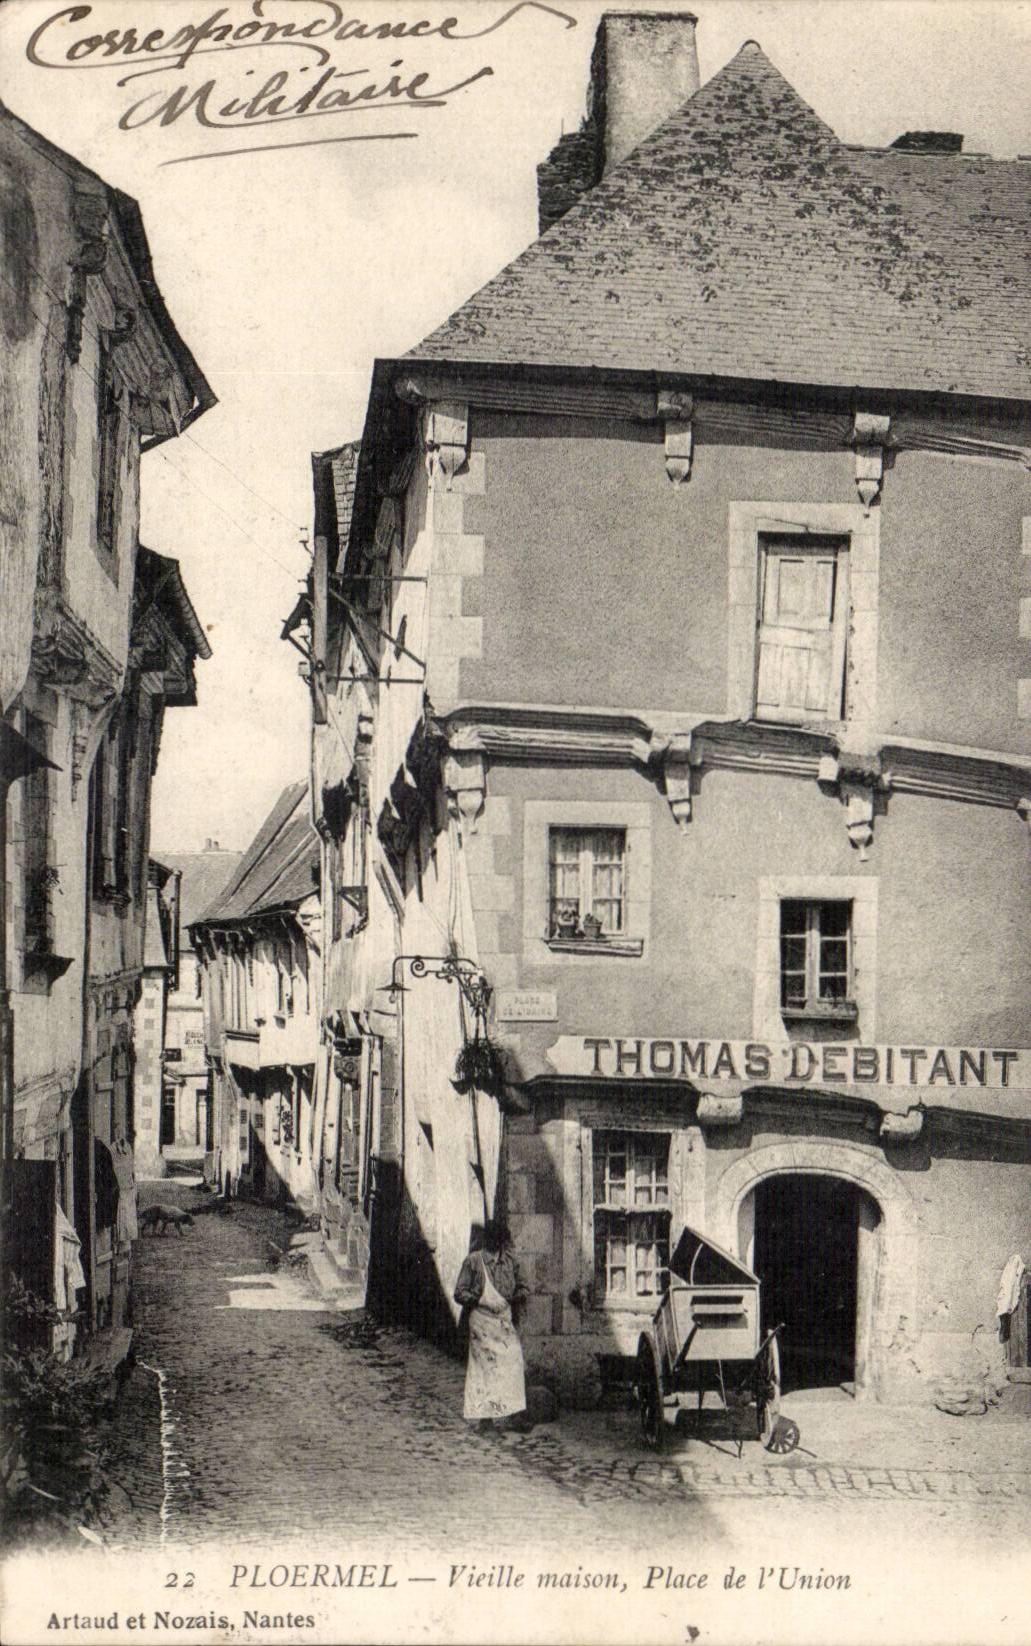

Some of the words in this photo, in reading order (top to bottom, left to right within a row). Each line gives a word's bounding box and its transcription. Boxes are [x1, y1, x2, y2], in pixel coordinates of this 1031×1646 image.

[26, 0, 560, 69] Correspondance
[118, 58, 493, 130] Militaire
[583, 1038, 772, 1081] THOMAS
